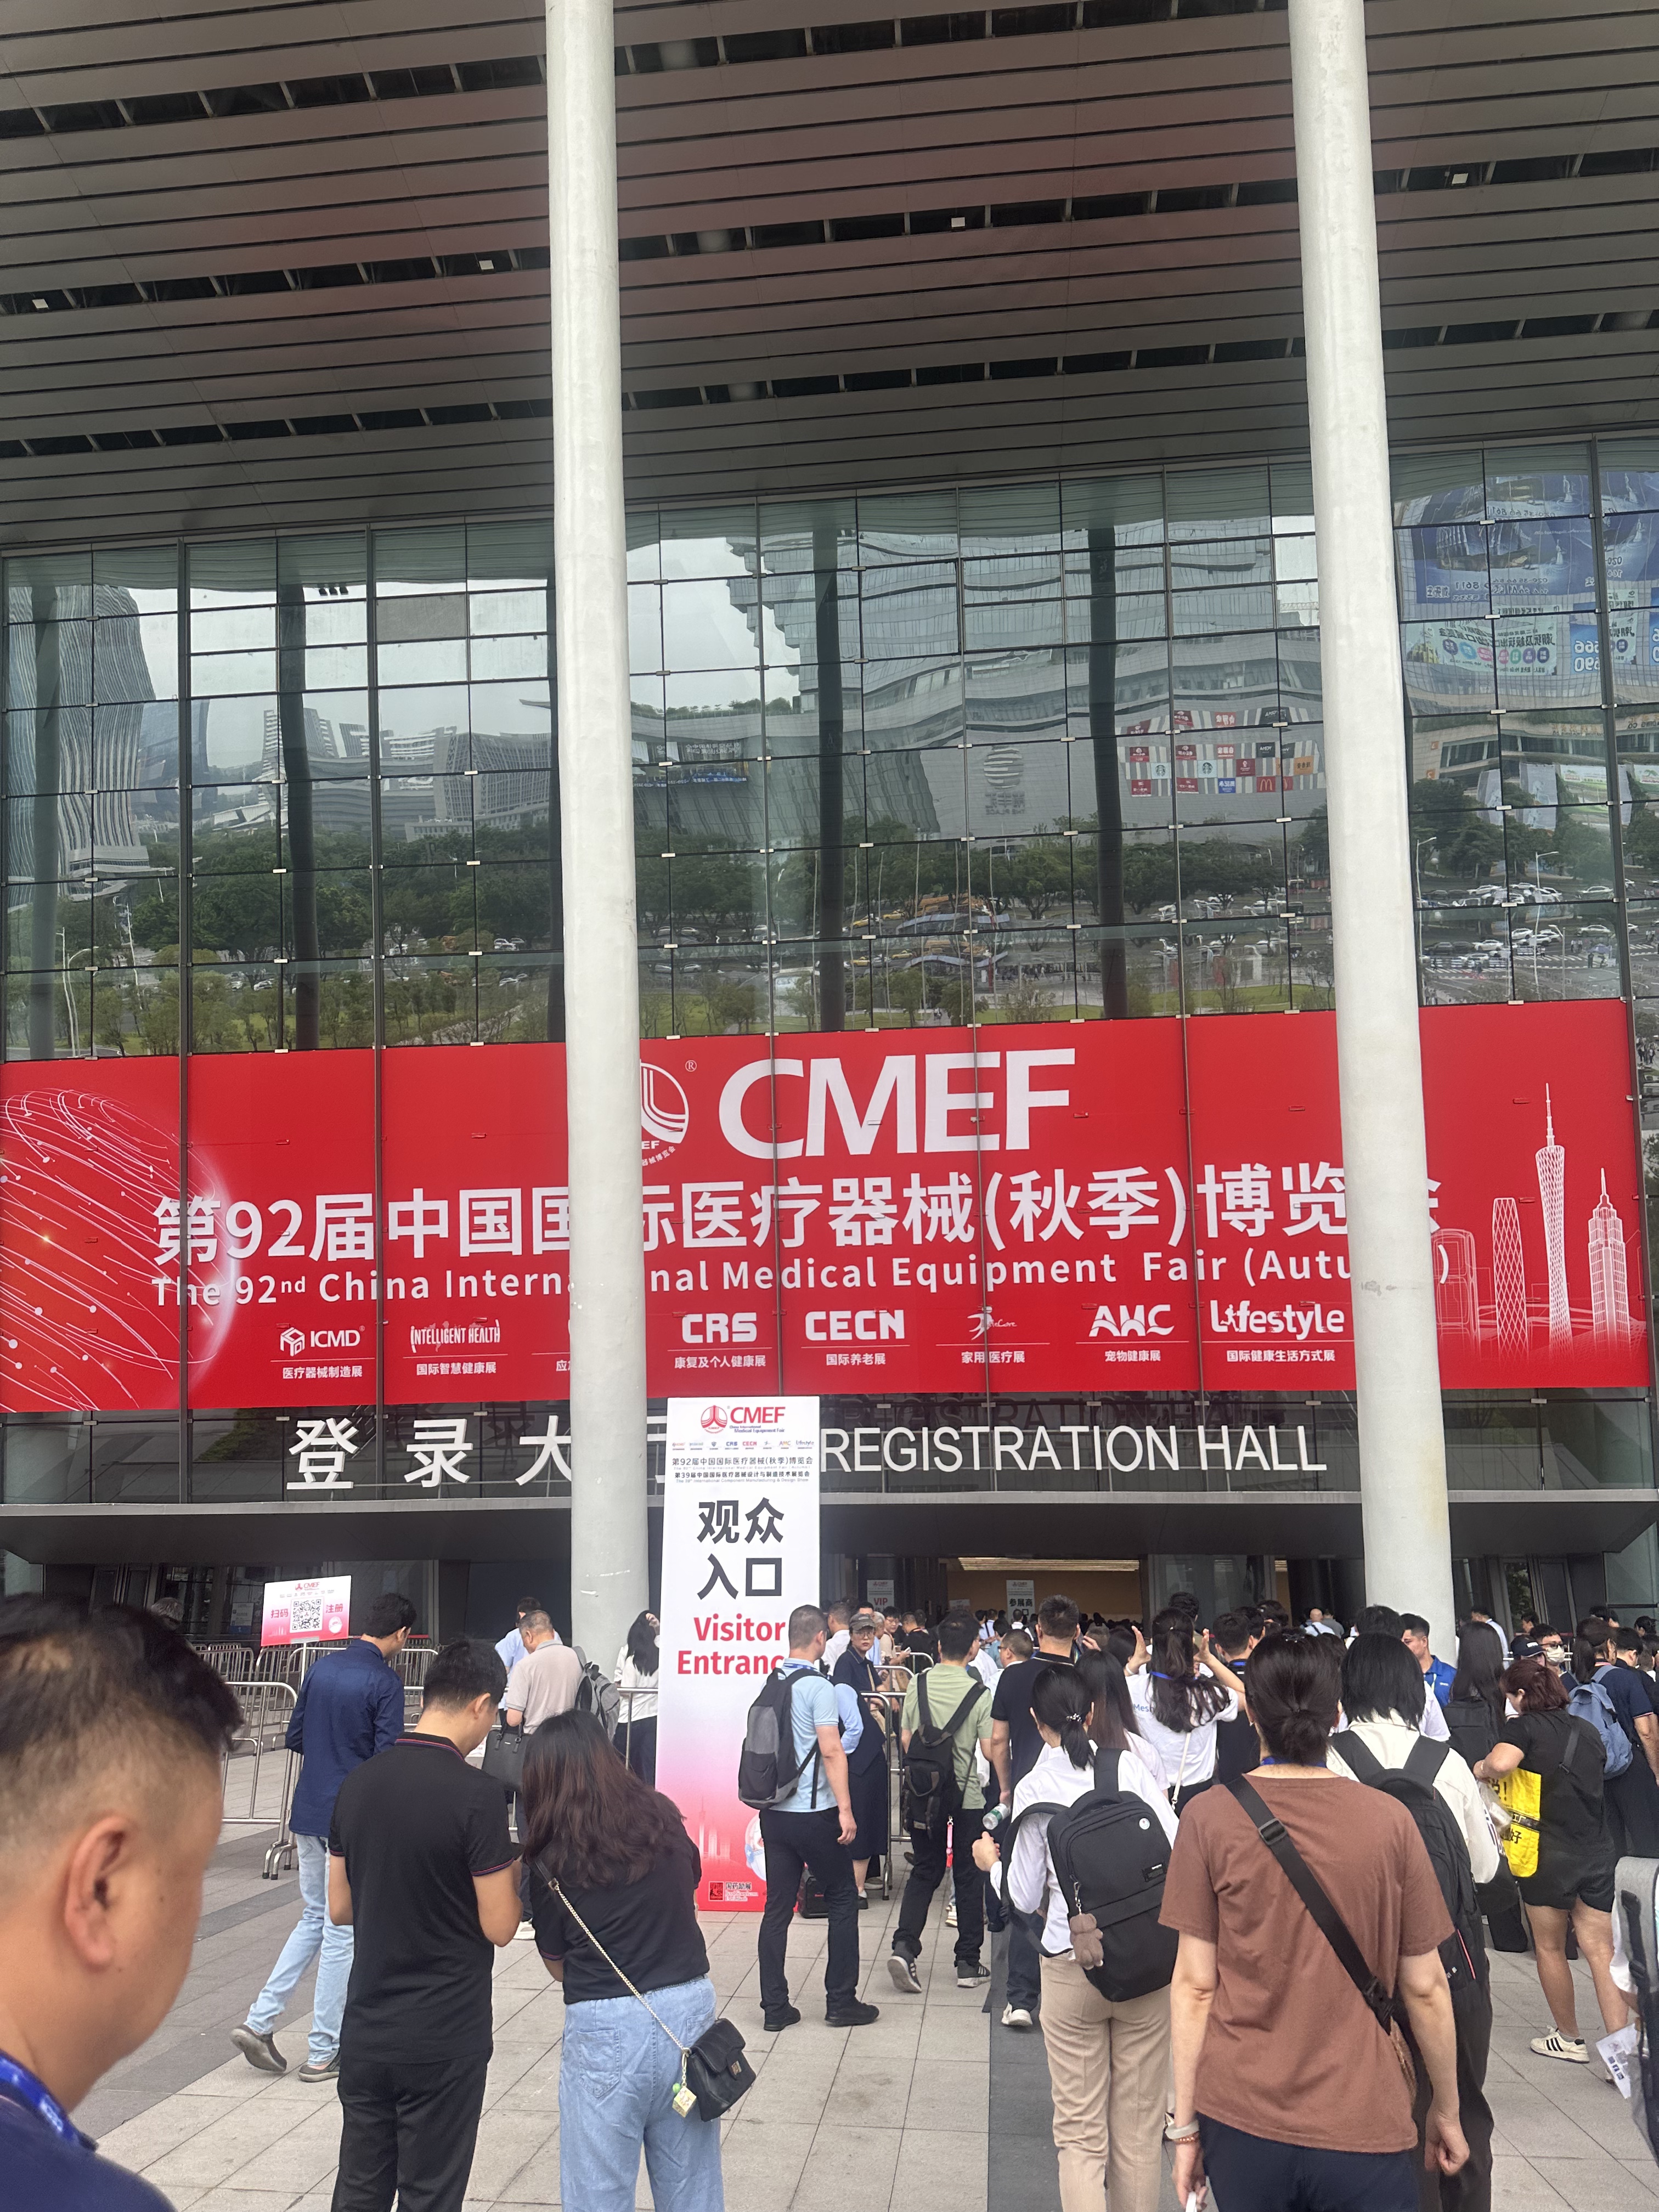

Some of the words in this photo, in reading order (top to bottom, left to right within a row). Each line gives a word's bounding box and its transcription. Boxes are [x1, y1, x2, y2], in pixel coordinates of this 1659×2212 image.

[718, 1047, 1076, 1160] CMEF
[641, 1140, 660, 1150] EF
[151, 1276, 221, 1307] The
[235, 1274, 306, 1305] 92nd
[319, 1271, 430, 1302] China
[446, 1260, 708, 1300] Internnal
[723, 1257, 877, 1290] Medical
[893, 1253, 1116, 1294] Equipment
[1144, 1250, 1227, 1282] Fair
[682, 1312, 758, 1344] CRS
[805, 1309, 905, 1341] CECN
[310, 1329, 361, 1348] ICMD
[674, 1354, 767, 1369] 康复及个人健康展
[826, 1352, 887, 1367] 国际养老展
[961, 1350, 1025, 1364] 家用医疗展
[1104, 1350, 1161, 1363] 宠物健康展
[1226, 1349, 1336, 1363] 国际健康生活方式展
[283, 1365, 363, 1380] 医疗器械制造展
[416, 1361, 497, 1376] 国际智慧健康展
[730, 1406, 786, 1424] CMEF
[821, 1425, 1179, 1472] REGISTRATION
[1198, 1425, 1327, 1471] HALL
[697, 1497, 785, 1544] 观众
[697, 1553, 782, 1600] 入口
[873, 1597, 888, 1606] VIP
[1009, 1598, 1033, 1607] 参展商
[270, 1608, 289, 1619] 扫码
[325, 1603, 343, 1614] 注册
[694, 1613, 786, 1641] Visitor
[678, 1650, 785, 1675] Entranc
